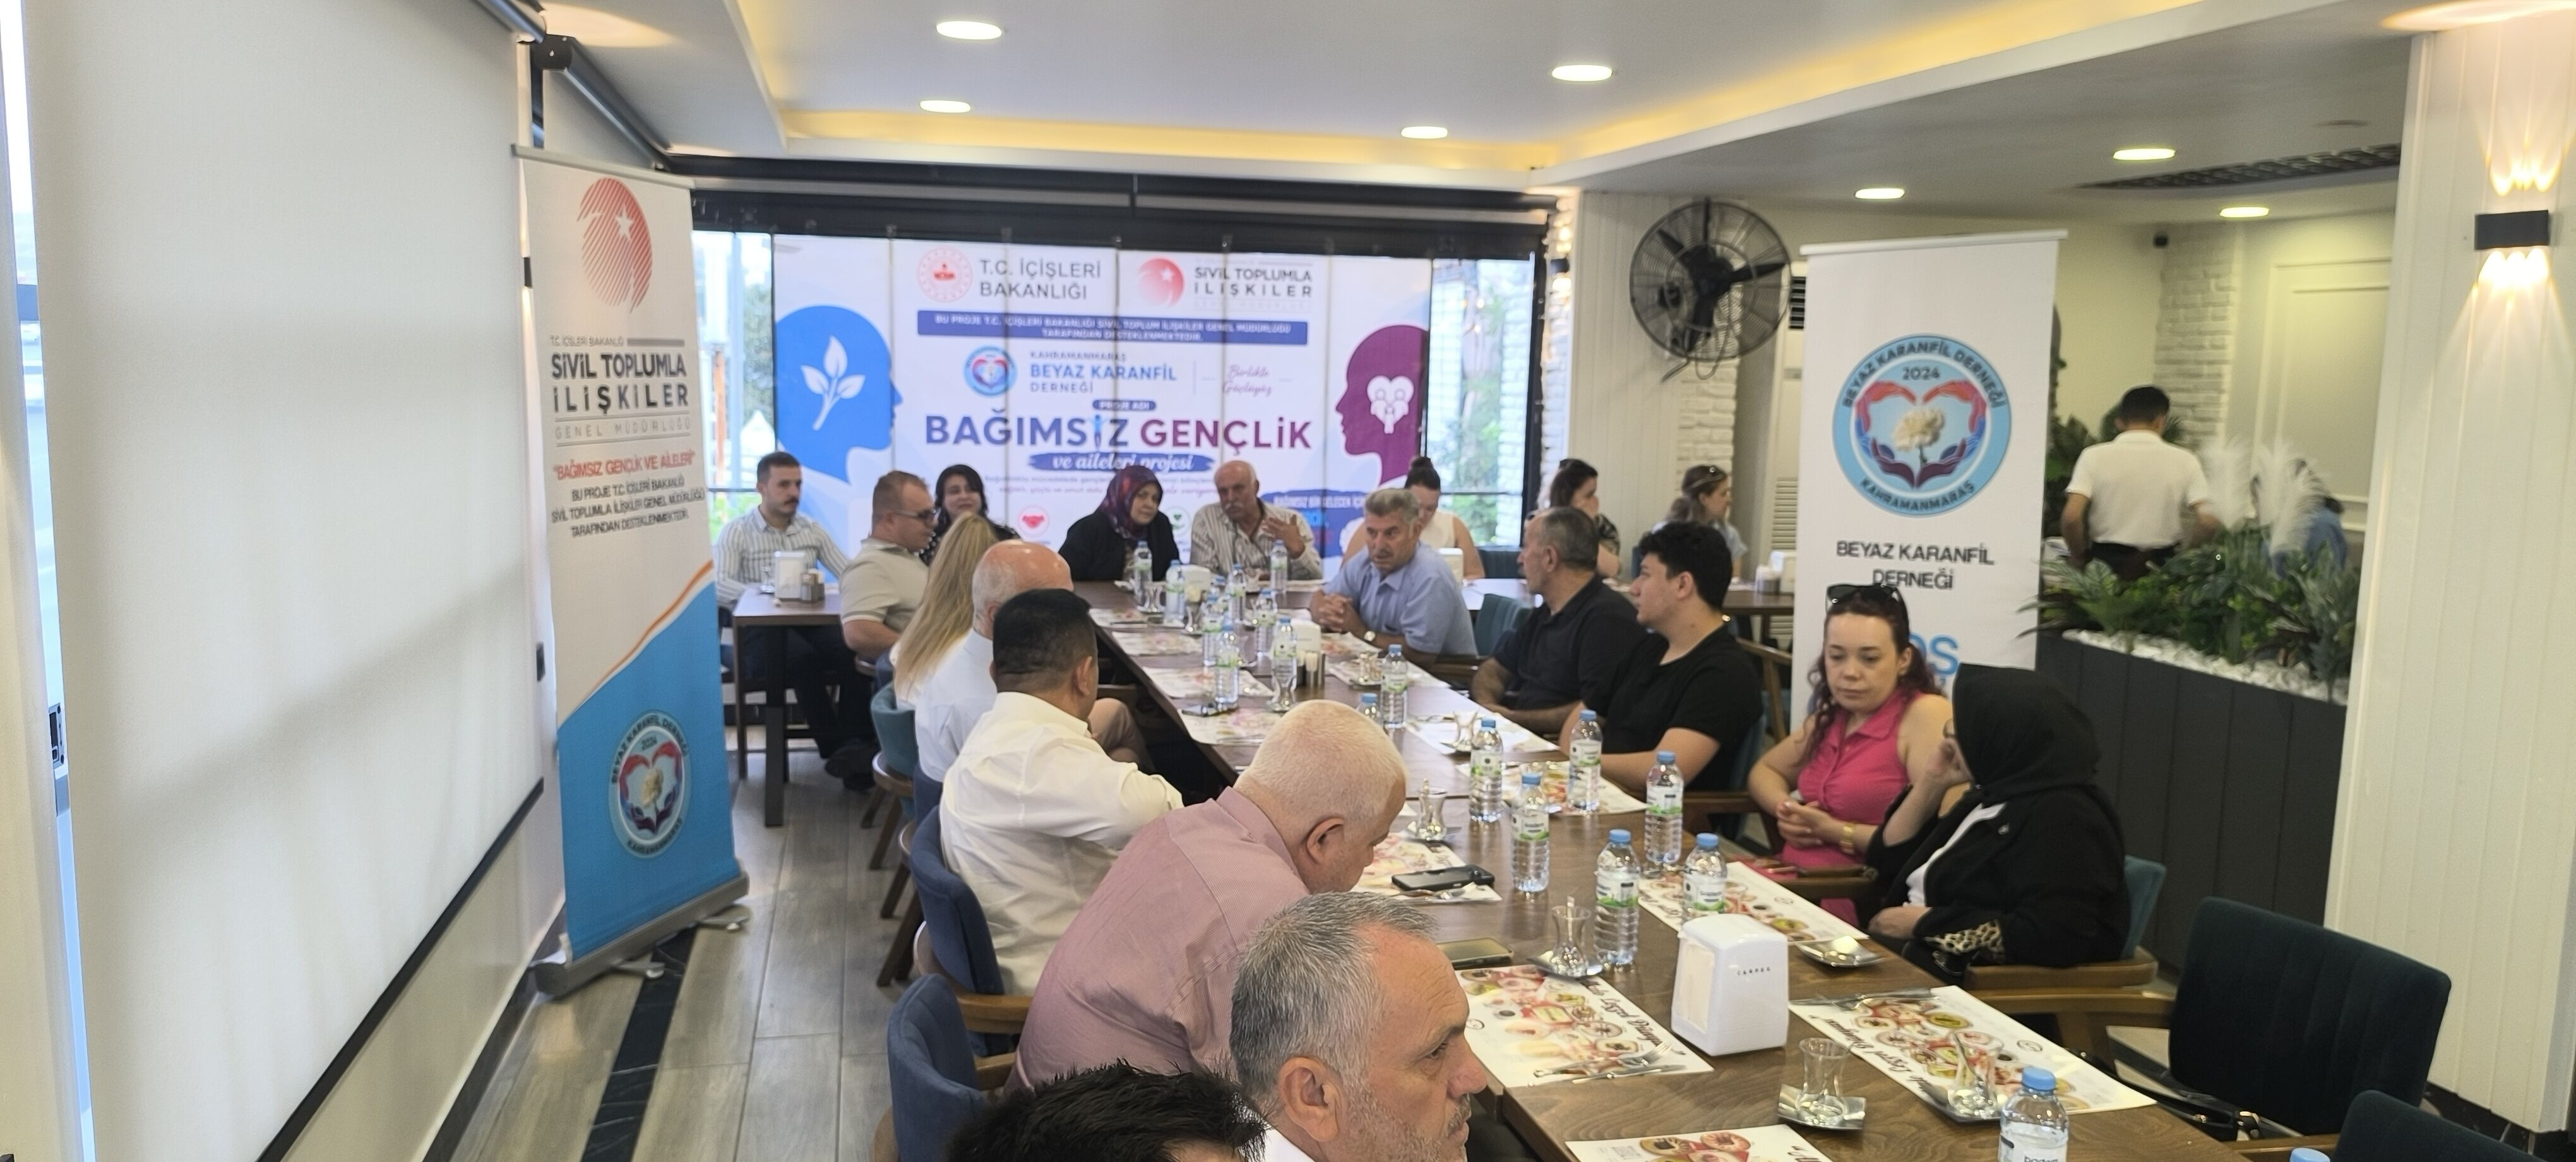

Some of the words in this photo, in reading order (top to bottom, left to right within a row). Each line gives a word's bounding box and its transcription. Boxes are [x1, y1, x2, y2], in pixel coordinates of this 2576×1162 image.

[979, 260, 1013, 275] T.C.
[1020, 258, 1101, 280] İÇİŞLERİ
[1236, 268, 1312, 282] TOPLUMLA
[980, 282, 1087, 300] BAKANLIĞI
[552, 353, 597, 379] SİVİL
[601, 352, 686, 378] TOPLUMLA
[1030, 364, 1085, 379] BEYAZ
[1091, 363, 1177, 381] KARANFİL
[1842, 359, 1877, 408] BEYAZ
[1875, 340, 1950, 364] KARANFİL
[1954, 349, 2007, 408] DERNEĞİ
[1902, 368, 1940, 380] 2024
[1030, 380, 1094, 393] DERNEĞİ
[554, 384, 688, 415] İLİŞKİLER
[555, 423, 603, 440] GENEL
[1140, 417, 1311, 455] GENÇLİK
[644, 455, 658, 469] VE
[1052, 457, 1072, 469] ve
[572, 489, 583, 501] BU
[1836, 541, 1894, 559] BEYAZ
[1898, 543, 1995, 565] KARANFİL
[1872, 568, 1955, 589] DERNEĞİ
